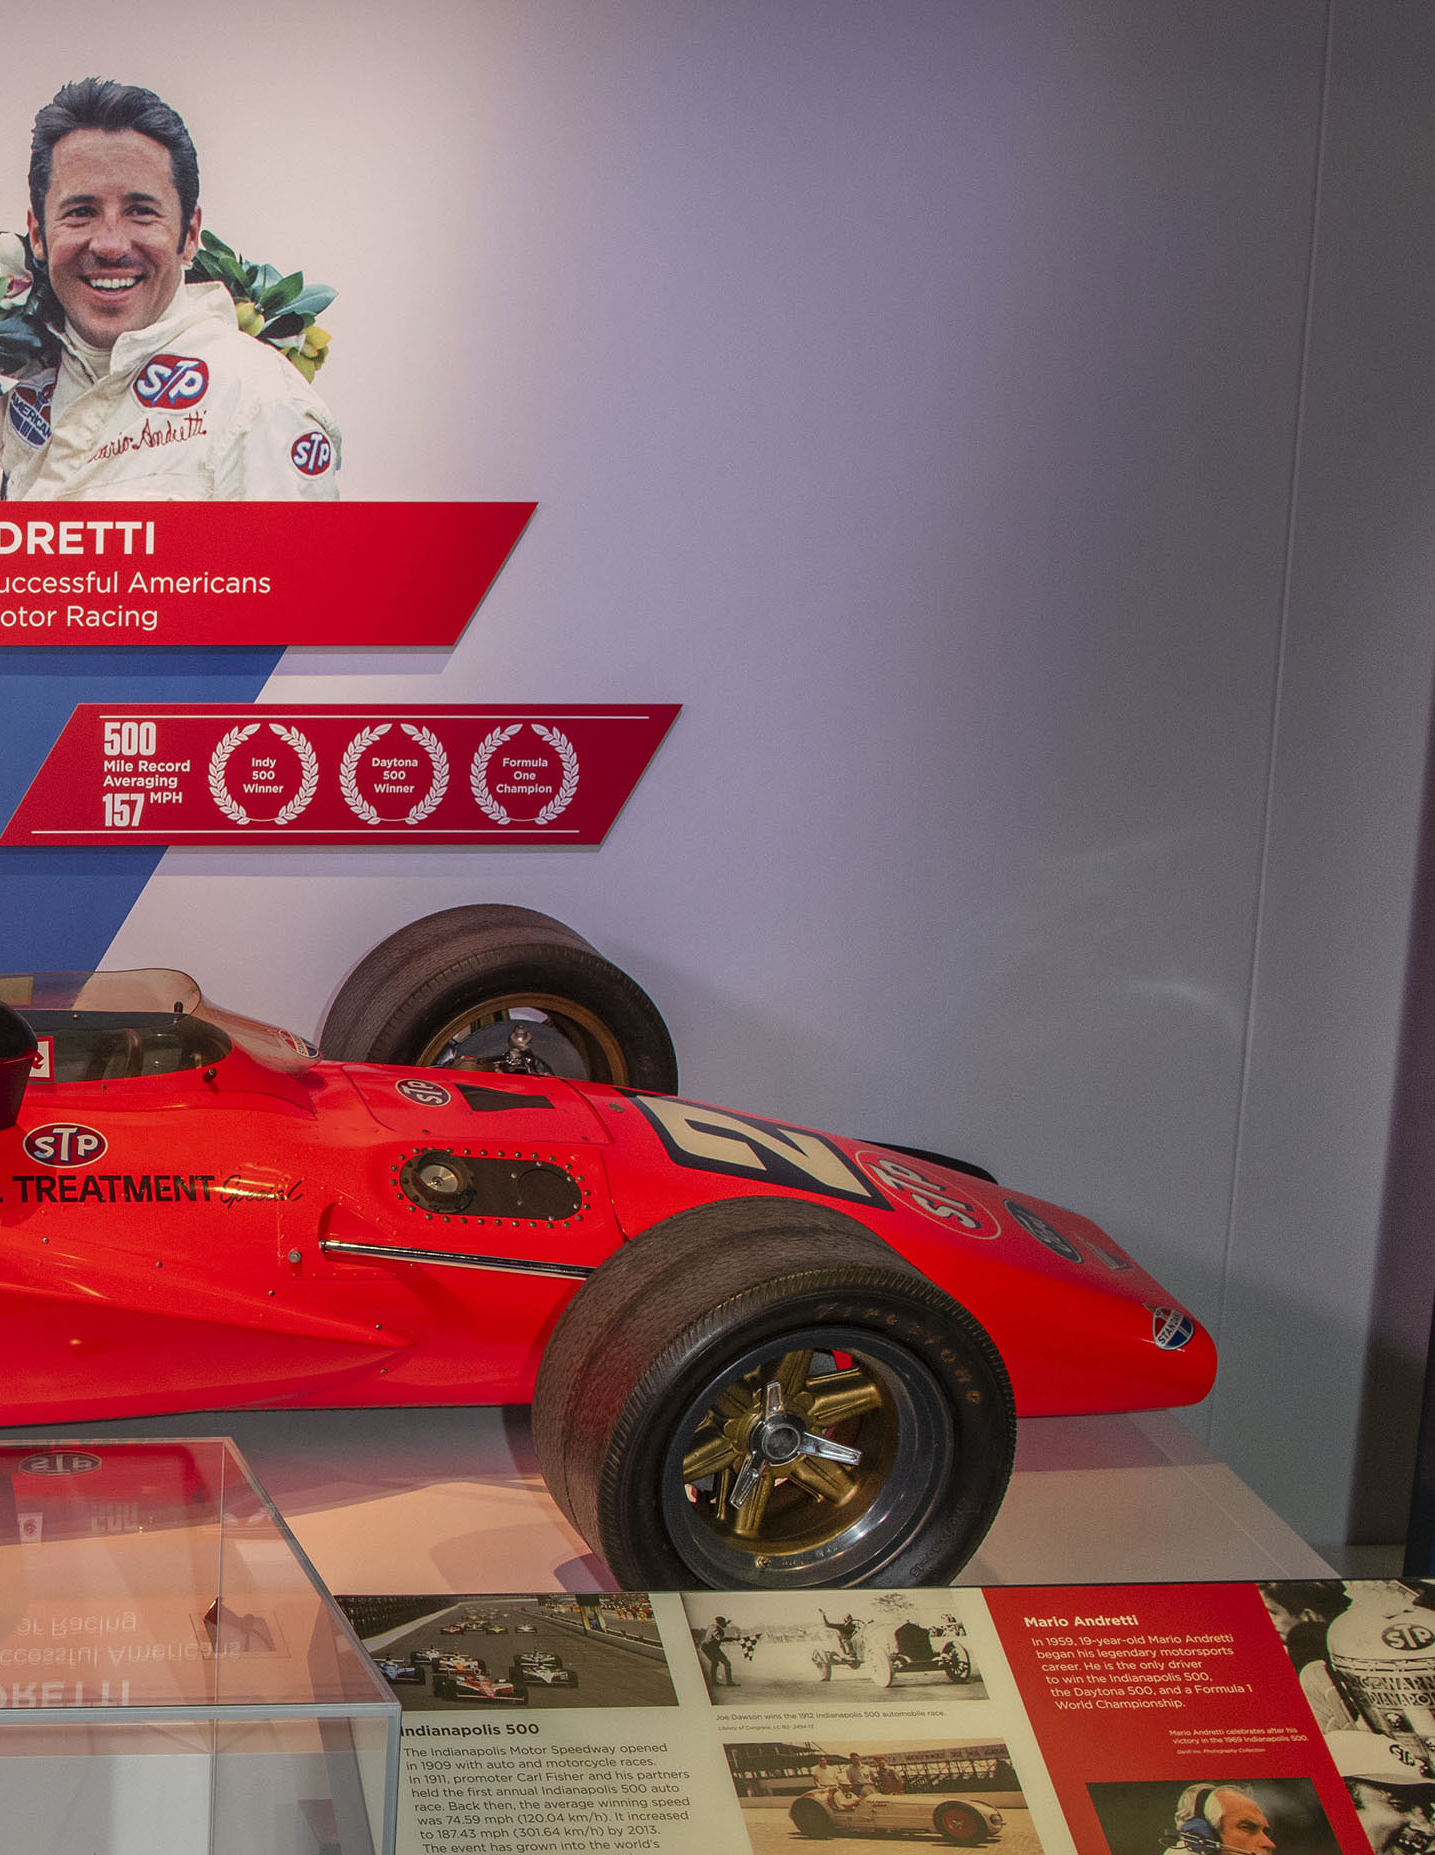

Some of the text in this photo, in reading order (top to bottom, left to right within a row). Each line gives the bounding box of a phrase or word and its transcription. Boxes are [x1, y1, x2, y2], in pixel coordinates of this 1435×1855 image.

[137, 360, 203, 402] STP
[87, 432, 133, 464] ario
[293, 434, 329, 471] STP
[128, 571, 270, 593] Americans
[67, 605, 158, 631] Racing
[104, 722, 156, 756] 500
[104, 760, 190, 772] Mile Record
[252, 757, 276, 768] Indy
[372, 758, 418, 769] Daytona
[503, 758, 548, 767] Formula
[103, 775, 178, 788] Averaging
[252, 771, 275, 780] 500
[383, 771, 406, 780] 500
[513, 771, 536, 780] One
[243, 784, 283, 793] Winner
[374, 784, 414, 793] Winner
[496, 784, 552, 794] Champion
[102, 792, 182, 827] 157 MPH
[401, 1081, 443, 1104] STP
[34, 1127, 99, 1164] STP
[636, 1095, 871, 1197] 2
[13, 1175, 215, 1202] TREATMENT
[866, 1158, 982, 1230] STP
[1024, 1614, 1138, 1627] Mario Andretti
[1032, 1634, 1234, 1646] In 1959, 19-year-old Mario Andretti
[1036, 1647, 1234, 1660] began his legendary motorsports
[1041, 1660, 1202, 1671] career. He is the only driver
[1046, 1672, 1213, 1684] to win the Indianapolis 500,
[1050, 1688, 1070, 1697] the
[1074, 1687, 1125, 1697] Daytona
[1127, 1686, 1156, 1695] 500,
[1159, 1686, 1181, 1694] and
[1194, 1684, 1245, 1694] Formula
[1246, 1684, 1253, 1693] 1
[1055, 1699, 1185, 1710] World Championship.
[401, 1724, 539, 1737] Indianapolis 500
[404, 1743, 667, 1757] The Indianapolis Motor Speedway opened
[406, 1758, 656, 1770] in 1909 with auto and motorcycle races.
[409, 1771, 690, 1785] In 1911, promoter Carl Fisher and his partners
[412, 1784, 679, 1797] held the first annual Indianapolis 500 auto
[449, 1802, 479, 1811] Back
[484, 1801, 515, 1810] then,
[519, 1801, 540, 1809] the
[544, 1801, 594, 1809] average
[598, 1799, 648, 1808] winning
[652, 1797, 690, 1807] speed
[417, 1811, 688, 1825] was 74.59 mph (120.04 km/h). It increased
[420, 1825, 660, 1839] to 187.43 mph (301.64 km/h) by 2013.
